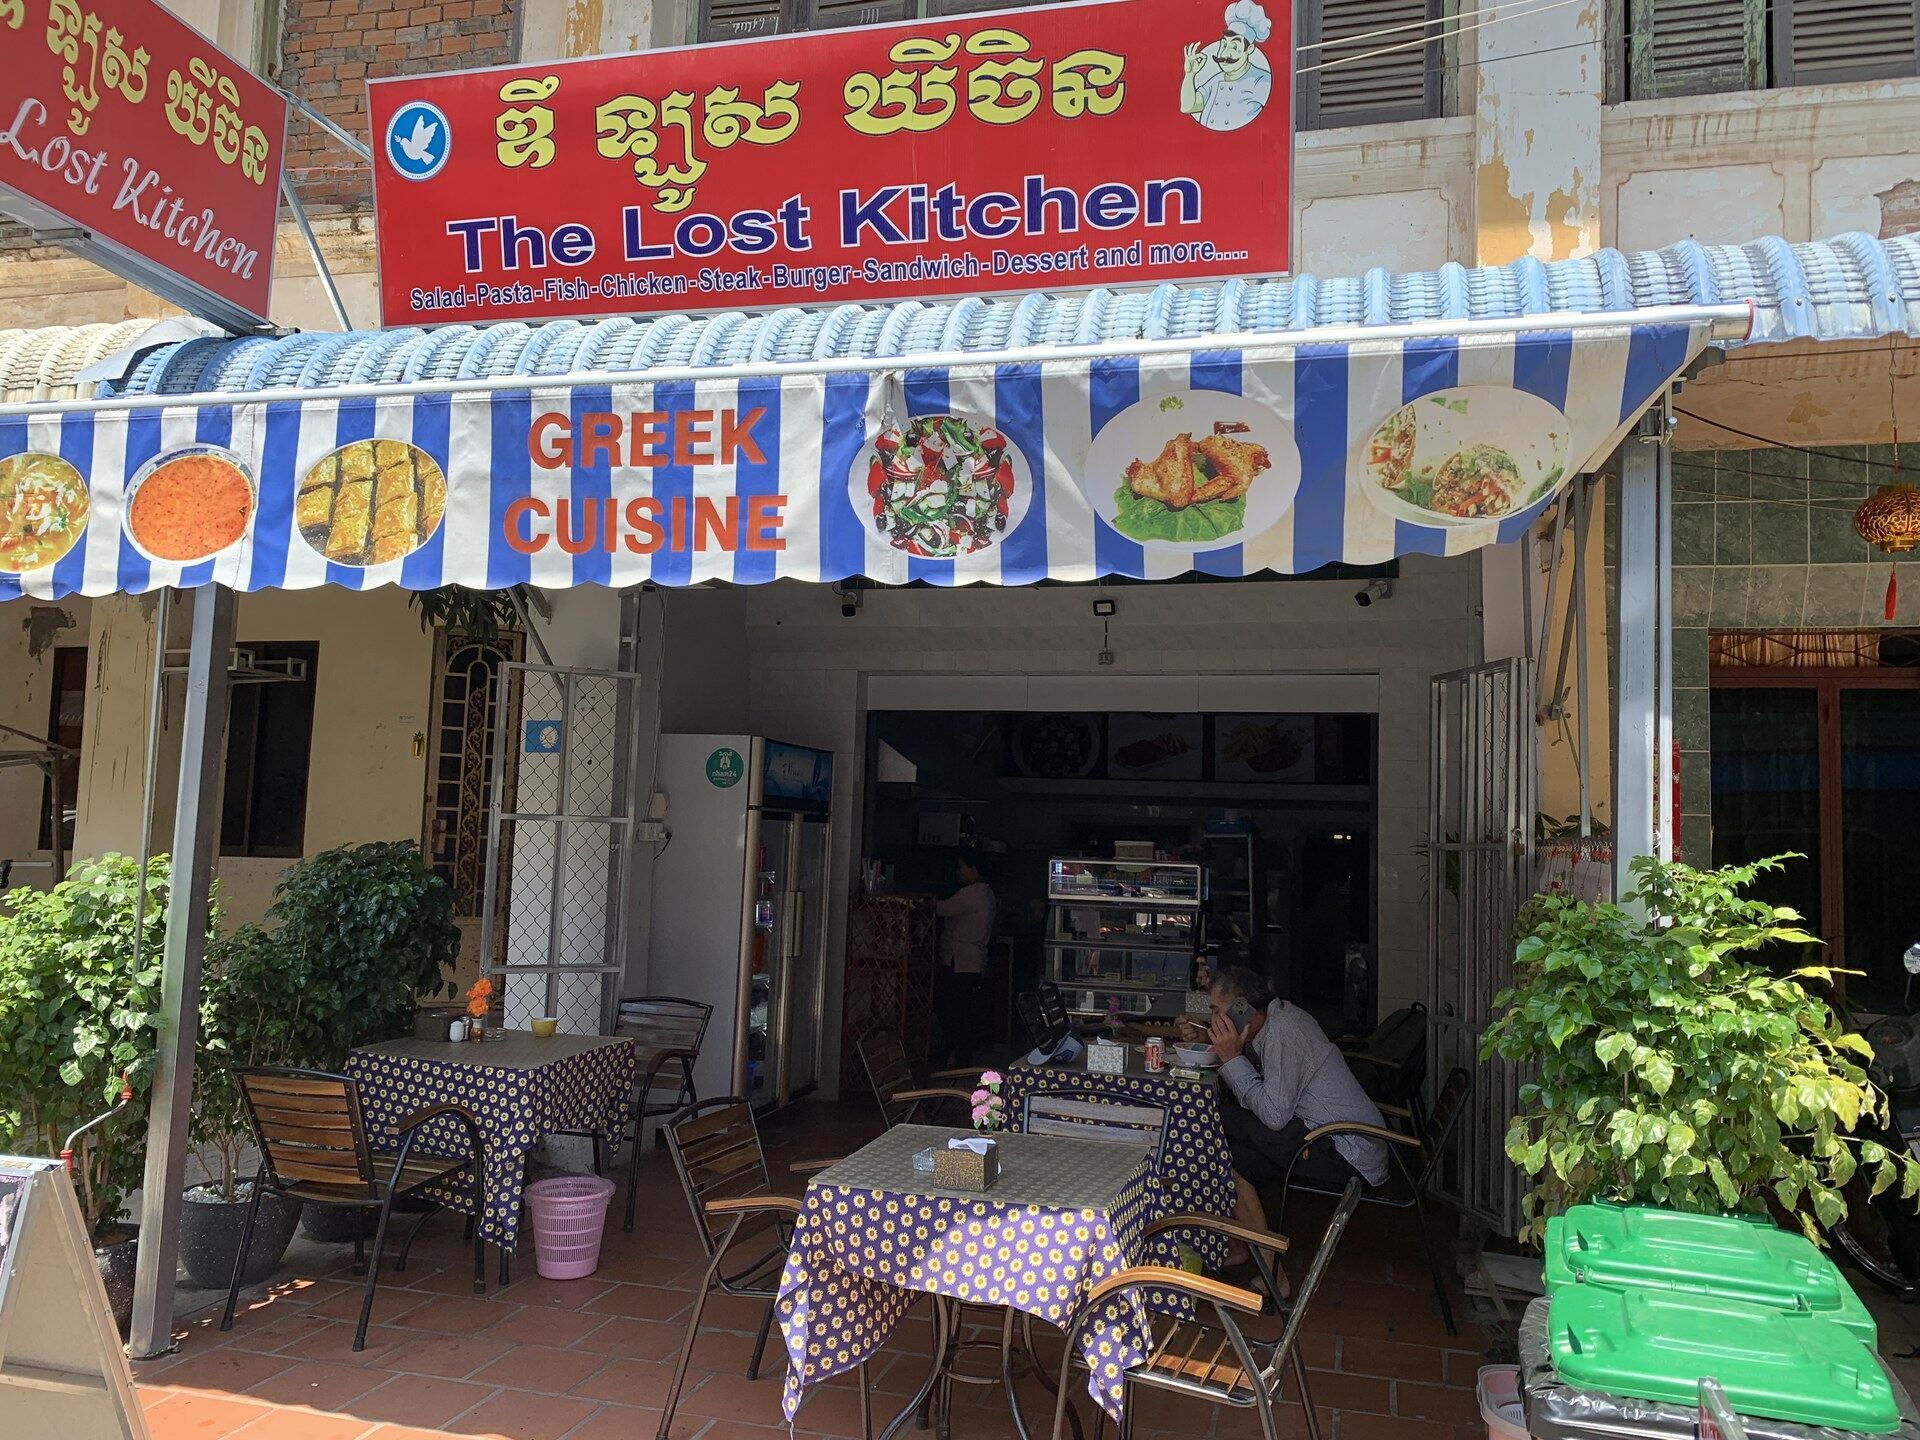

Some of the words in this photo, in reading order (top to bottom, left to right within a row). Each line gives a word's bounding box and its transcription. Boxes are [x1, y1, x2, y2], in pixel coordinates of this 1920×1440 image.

[0, 97, 108, 195] Lost
[112, 157, 259, 280] Kitchen
[446, 216, 596, 274] The
[622, 193, 812, 262] Lost
[840, 174, 1202, 248] Kitchen
[1094, 240, 1142, 268] and
[528, 407, 767, 469] GREEK
[503, 495, 787, 554] CUISINE
